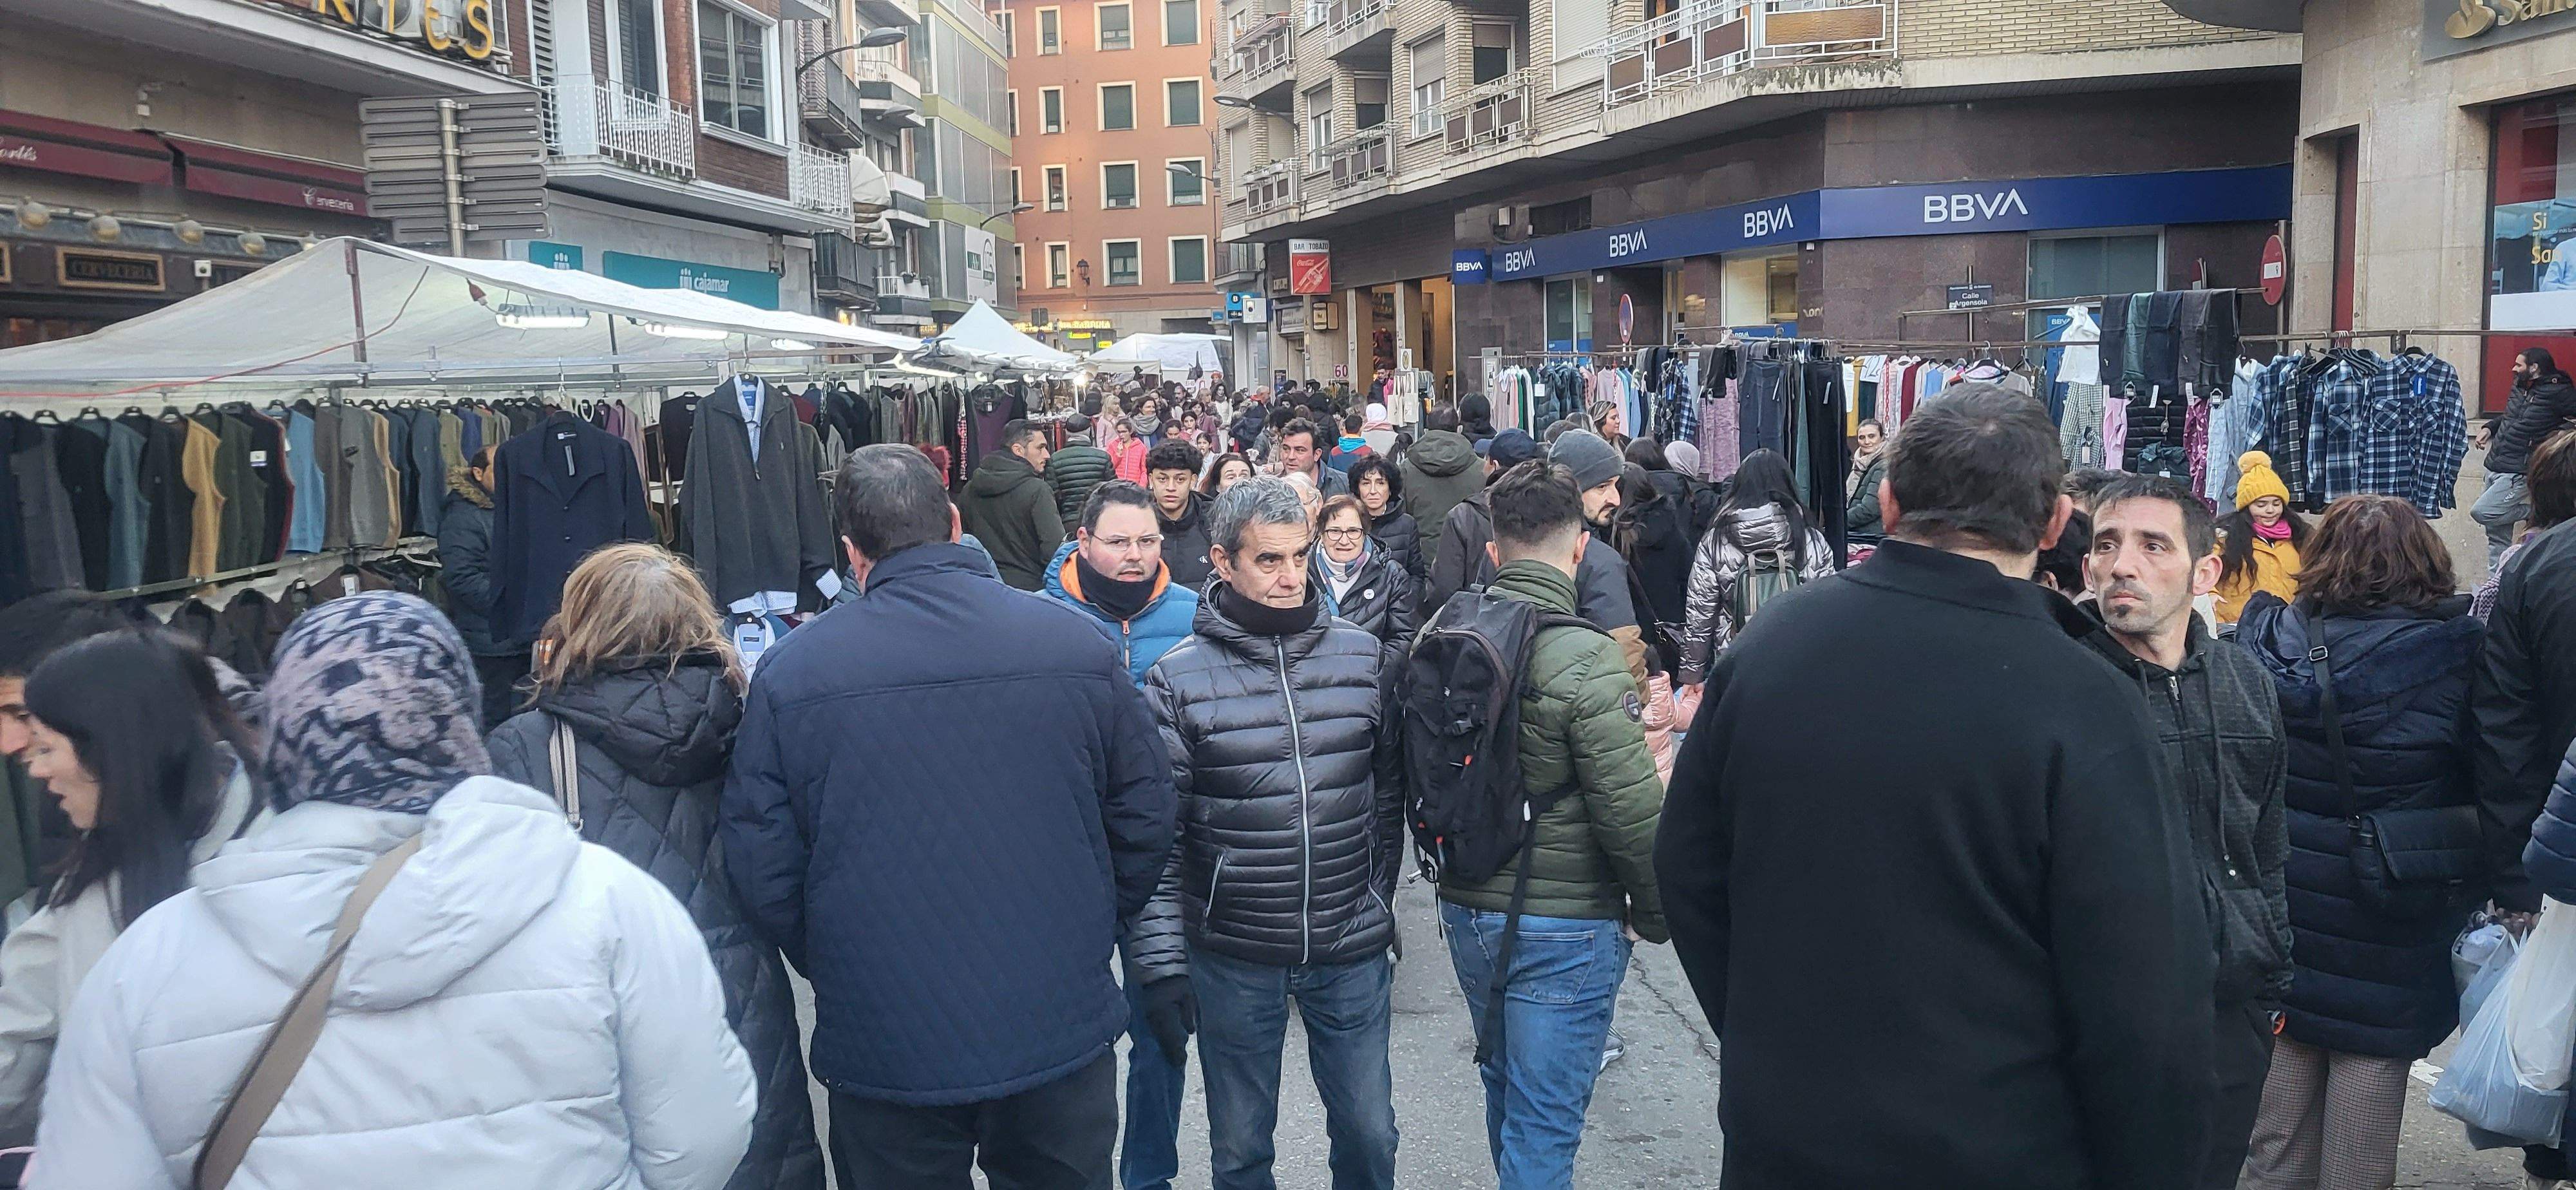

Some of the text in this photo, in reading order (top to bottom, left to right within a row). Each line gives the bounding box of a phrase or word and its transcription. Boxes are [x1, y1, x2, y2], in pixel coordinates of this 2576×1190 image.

[1924, 188, 2028, 223] BBVA
[1744, 203, 1794, 238] BBVA
[2532, 212, 2547, 231] Si
[1609, 227, 1647, 258] BBVA
[1456, 261, 1482, 272] BBVA
[1506, 247, 1536, 272] BBVA
[694, 272, 729, 294] cajamar
[1955, 299, 1987, 307] Argensola
[1335, 364, 1348, 377] 60
